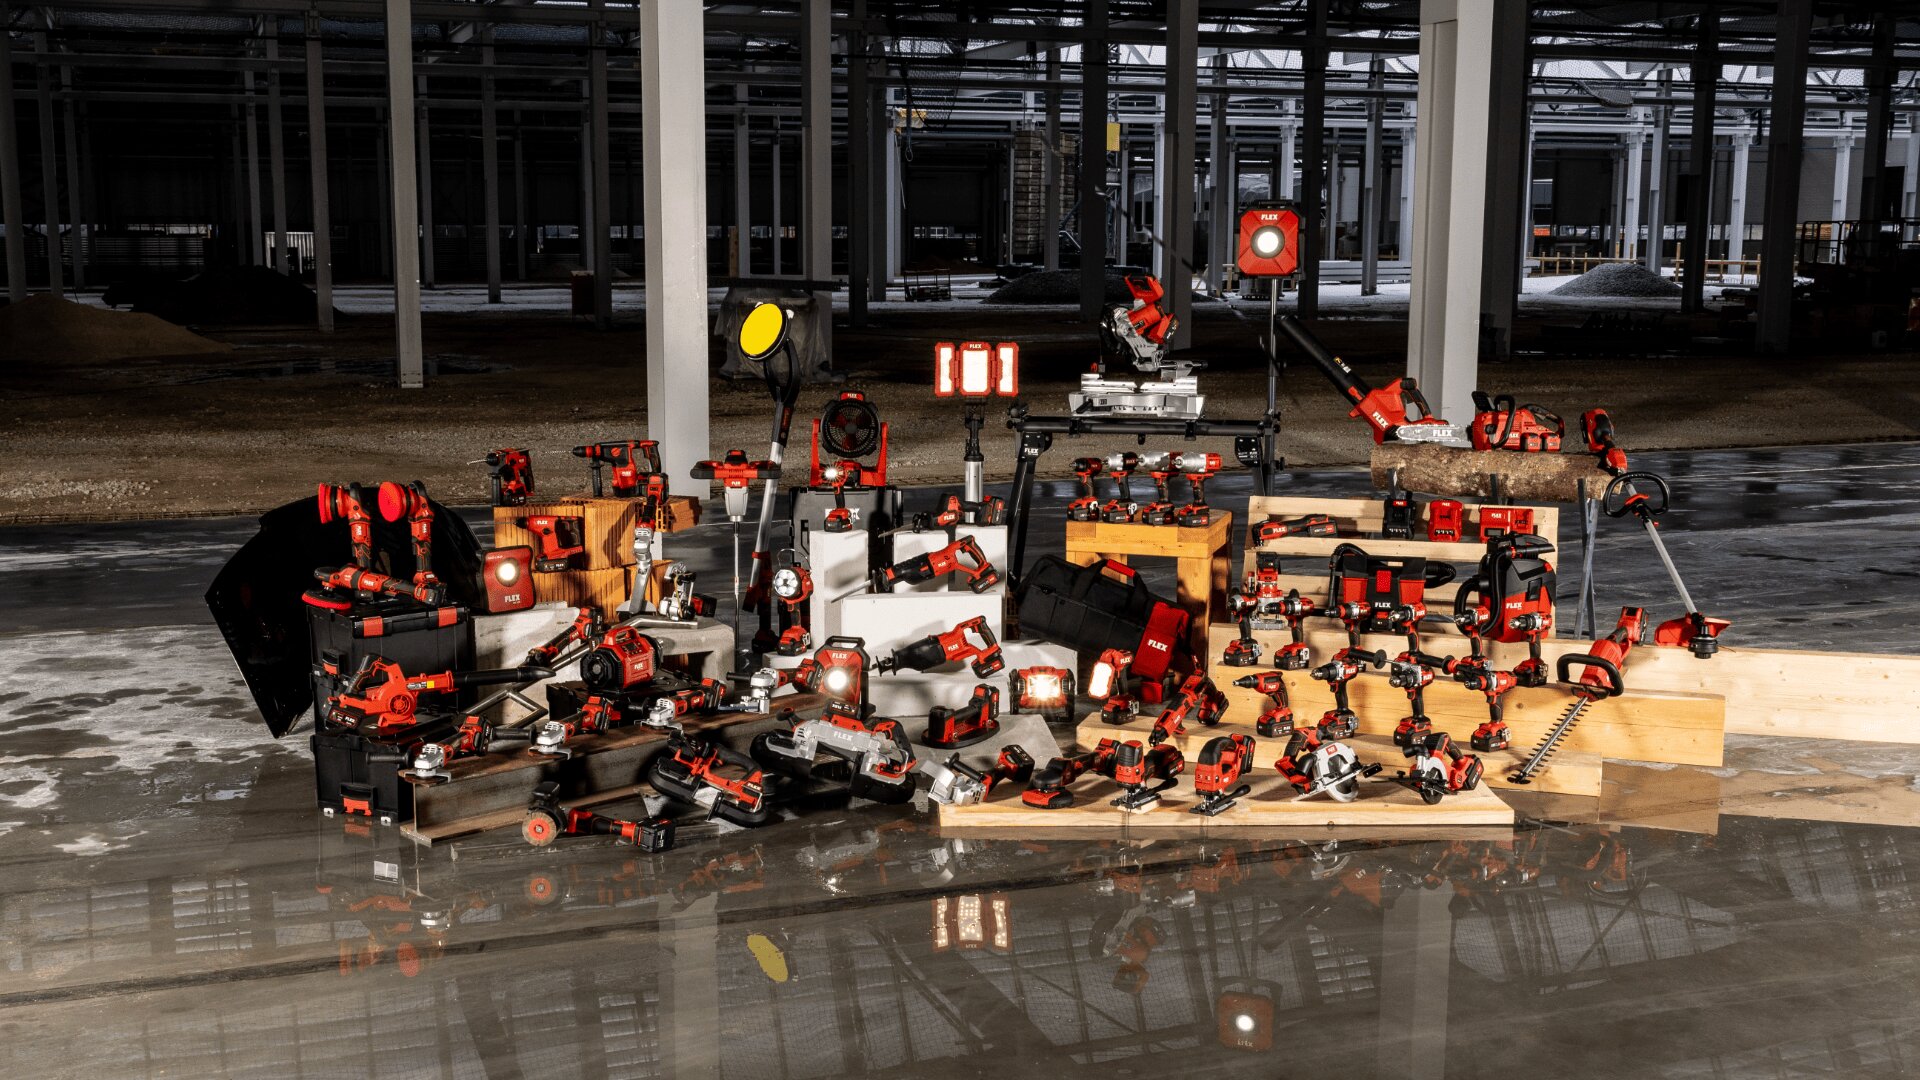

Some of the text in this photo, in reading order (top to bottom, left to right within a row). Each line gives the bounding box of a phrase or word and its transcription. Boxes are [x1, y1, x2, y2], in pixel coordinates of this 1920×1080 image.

[1372, 412, 1388, 428] FLEX
[505, 594, 520, 603] FLEX
[1148, 640, 1168, 652] FLEX
[834, 731, 852, 741] FLEX
